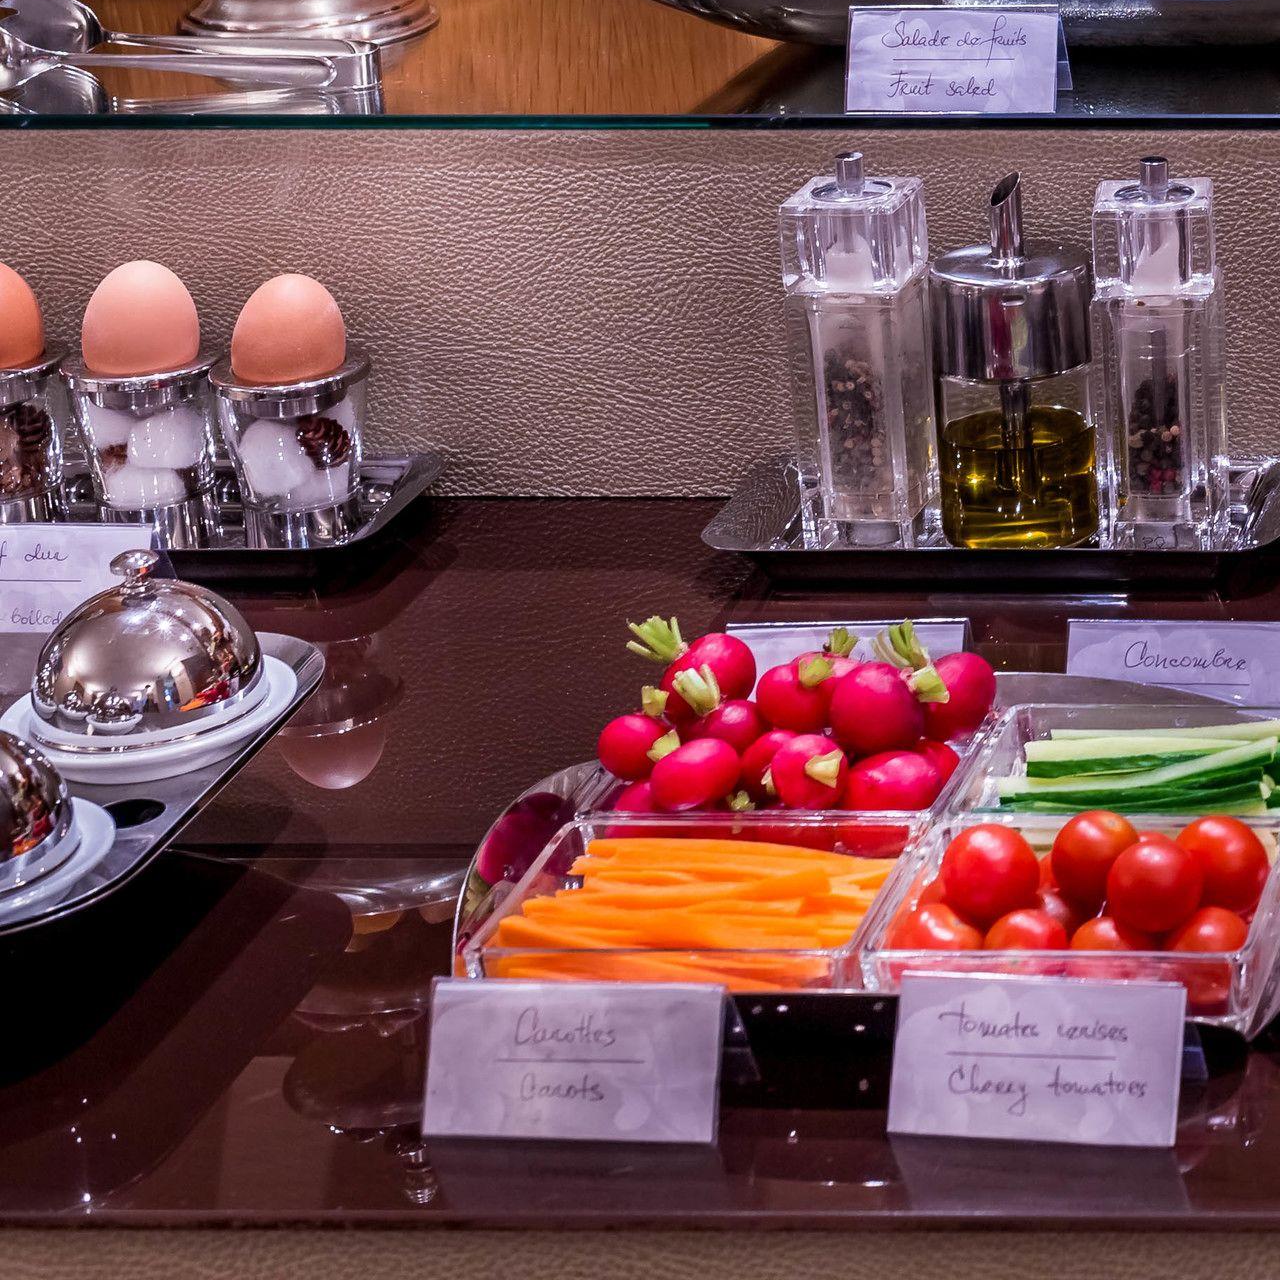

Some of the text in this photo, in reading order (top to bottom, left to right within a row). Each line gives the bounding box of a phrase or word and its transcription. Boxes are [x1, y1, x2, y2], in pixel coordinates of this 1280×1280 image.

[881, 20, 950, 48] Salade
[957, 31, 979, 47] de
[887, 70, 932, 97] Fruit
[1124, 640, 1248, 671] Concombre
